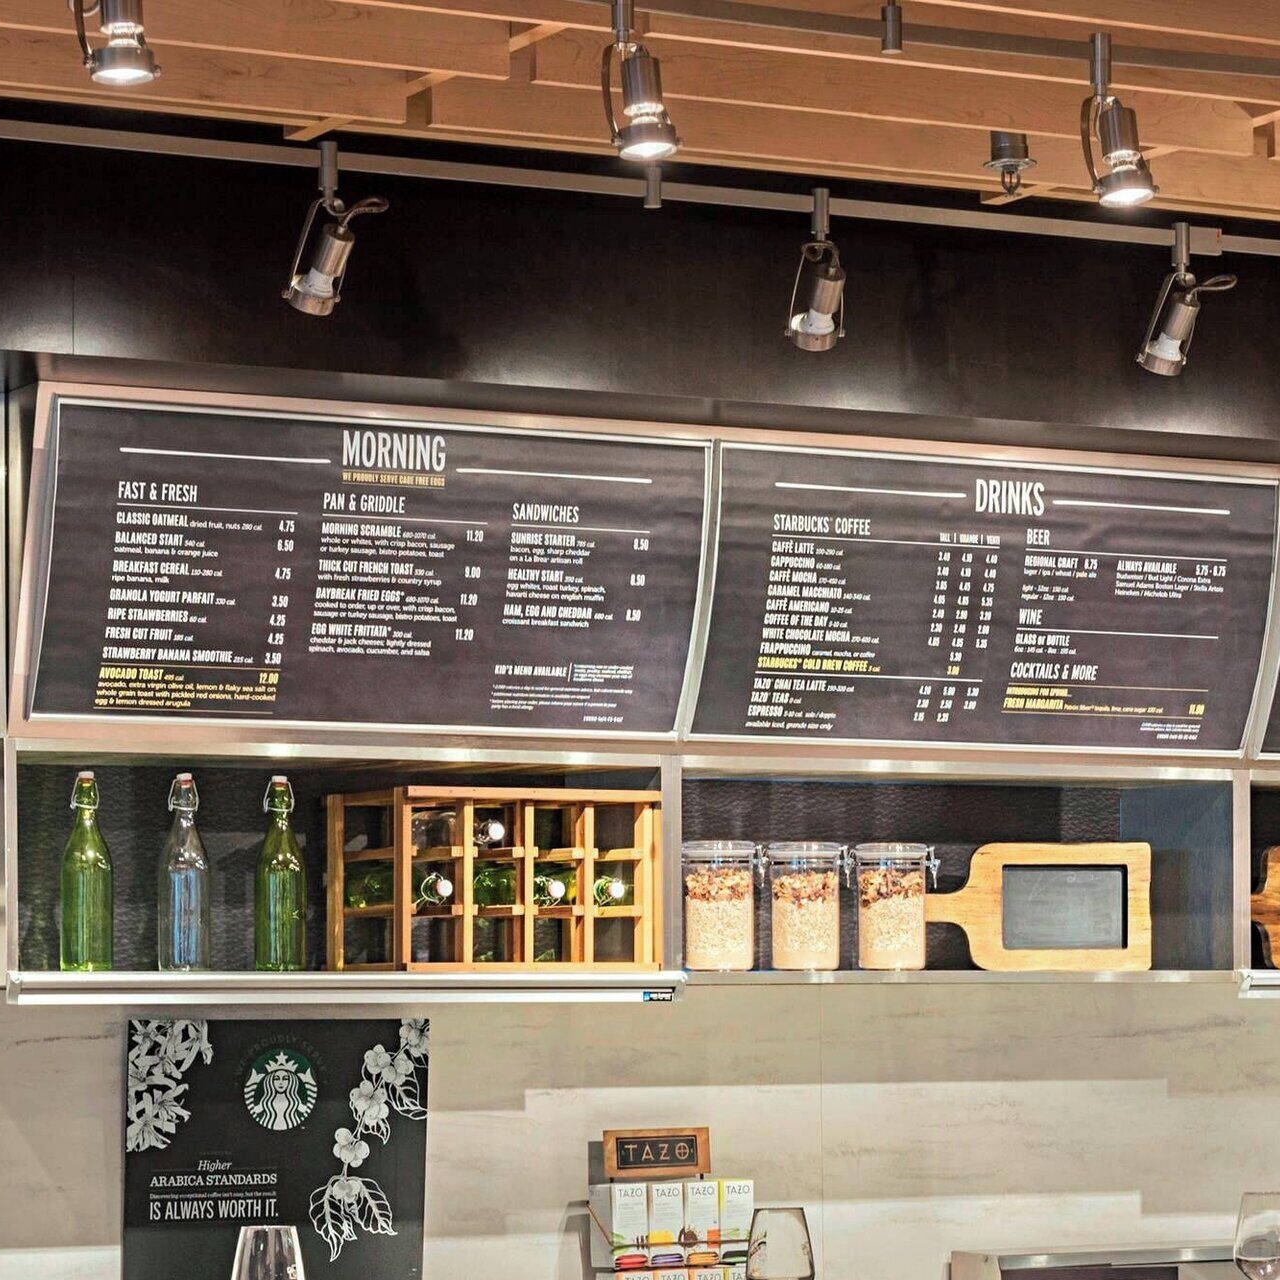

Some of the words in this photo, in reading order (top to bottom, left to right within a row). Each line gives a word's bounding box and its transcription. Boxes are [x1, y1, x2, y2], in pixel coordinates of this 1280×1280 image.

[343, 431, 445, 471] MORNING
[342, 472, 351, 481] WE
[353, 473, 379, 483] PROUDLY
[380, 475, 398, 484] SERVE
[399, 476, 414, 485] CAGE
[415, 477, 429, 485] FREE
[430, 477, 445, 486] EGGS
[119, 481, 146, 499] FAST
[150, 483, 157, 500] &
[162, 484, 197, 502] FRESH
[976, 479, 1044, 515] DRINKS
[324, 493, 344, 509] PAN
[349, 494, 356, 511] &
[361, 495, 405, 513] GRIDDLE
[117, 512, 150, 524] CLASSIC
[152, 514, 188, 527] OATMEAL
[513, 504, 579, 522] SANDWICHES
[279, 520, 294, 532] 4.75
[322, 523, 358, 535] MORNING
[360, 525, 401, 537] SCRAMBLE
[835, 518, 870, 535] COFFEE
[115, 532, 157, 544] BALANCED
[159, 534, 183, 546] START
[467, 530, 483, 542] 11.20
[511, 532, 542, 545] SUNRISE
[545, 534, 575, 546] STARTER
[1027, 529, 1050, 545] BEER
[278, 540, 293, 551] 6.50
[634, 539, 649, 550] 8.50
[113, 560, 158, 573] BREAKFAST
[160, 562, 189, 575] CEREAL
[319, 559, 341, 571] THICK
[343, 561, 357, 572] CUT
[359, 562, 388, 573] FRENCH
[391, 563, 413, 575] TOAST
[771, 556, 815, 568] CAPPUCCINO
[1117, 560, 1142, 571] ALWAYS
[1143, 562, 1176, 573] AVAILABLE
[508, 569, 540, 581] HEALTHY
[541, 570, 563, 582] START
[770, 569, 791, 582] CAFFÈ
[792, 572, 817, 583] MOCHA
[110, 589, 147, 601] GRANOLA
[150, 590, 180, 602] YOGURT
[182, 592, 214, 604] PARFAIT
[768, 585, 800, 597] CARAMEL
[802, 587, 842, 599] MACCHIATO
[108, 608, 126, 620] RIPE
[128, 609, 188, 622] STRAWBERRIES
[1019, 609, 1042, 624] WINE
[103, 647, 156, 659] STRAWBERRY
[157, 649, 190, 661] BANANA
[192, 650, 232, 662] SMOOTHIE
[99, 667, 137, 679] AVOCADO
[139, 669, 163, 680] TOAST
[260, 673, 278, 684] 12.00
[1011, 663, 1060, 679] COCKTAILS
[1062, 664, 1069, 679] &
[1071, 665, 1098, 680] MORE
[624, 1142, 689, 1162] TAZO
[197, 1160, 233, 1172] Higher
[149, 1175, 204, 1187] ARABICA
[206, 1173, 277, 1186] STANDARDS
[619, 1187, 643, 1198] TAZO
[655, 1187, 680, 1197] TAZO
[690, 1186, 715, 1196] TAZO
[726, 1184, 750, 1195] TAZO
[149, 1202, 161, 1221] IS
[164, 1200, 214, 1220] ALWAYS
[218, 1199, 262, 1218] WORTH
[265, 1199, 279, 1217] IT.
